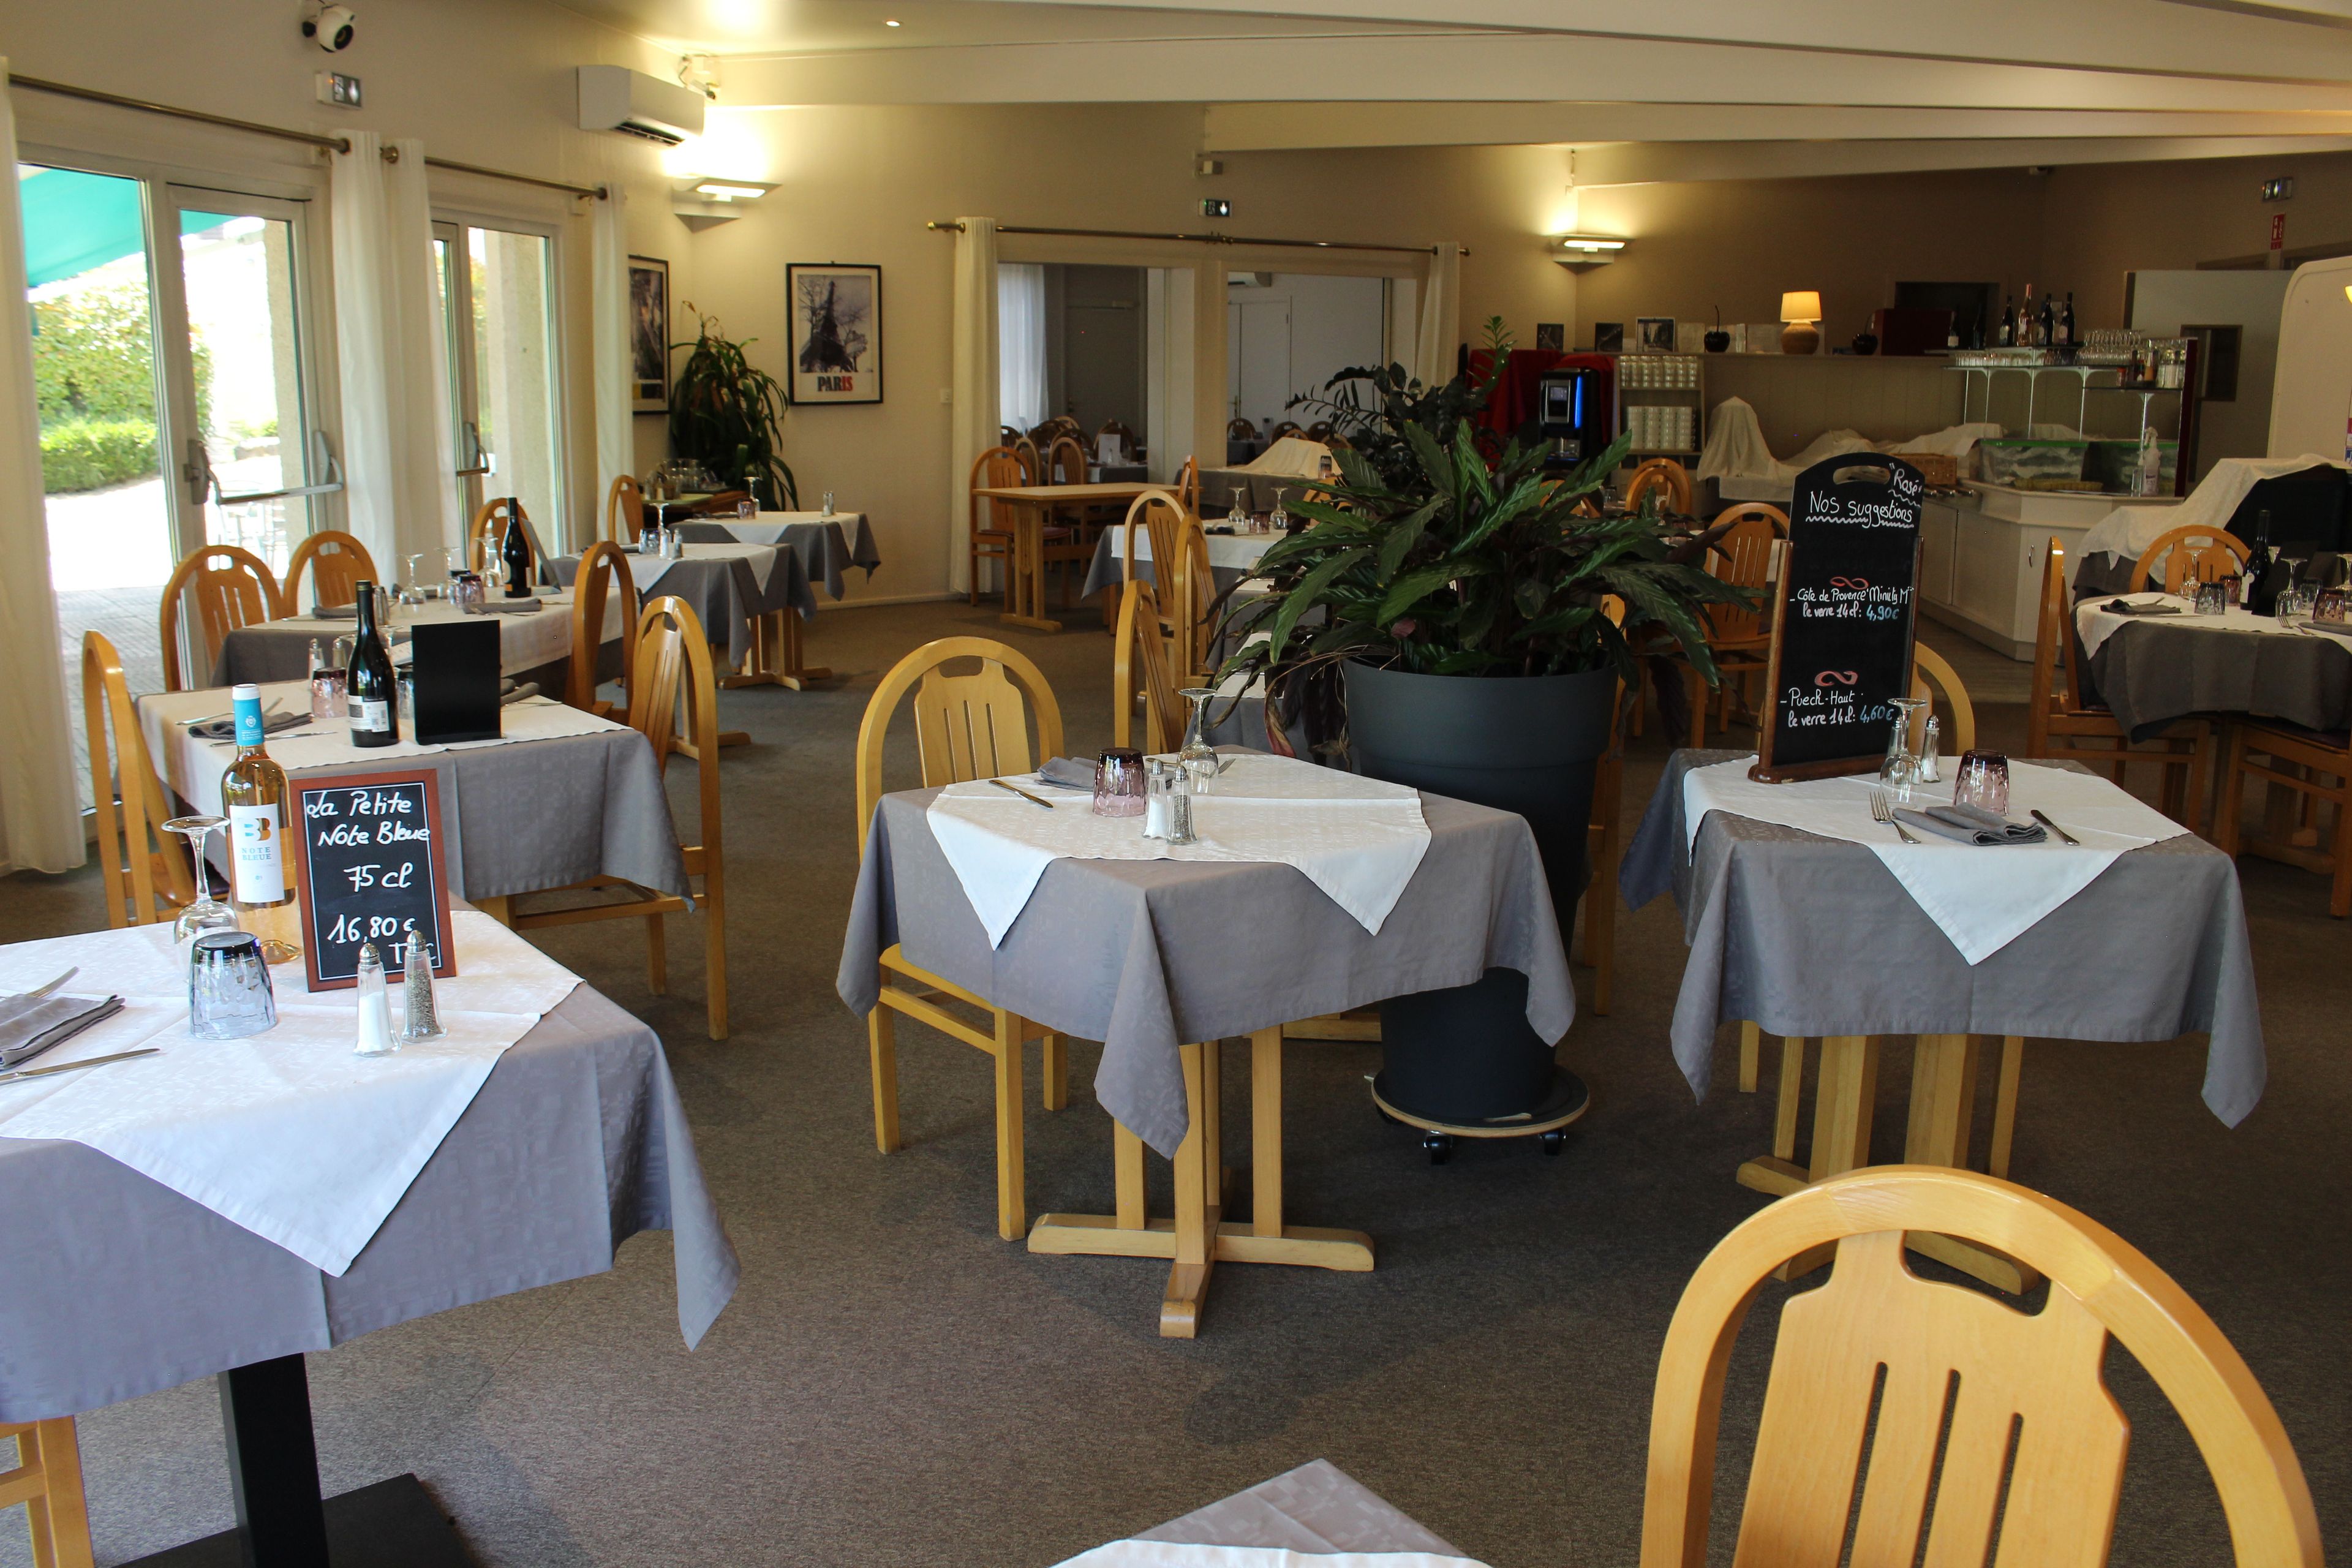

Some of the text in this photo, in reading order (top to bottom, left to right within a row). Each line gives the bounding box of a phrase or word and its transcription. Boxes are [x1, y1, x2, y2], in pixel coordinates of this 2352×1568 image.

[817, 375, 853, 391] PARIS
[1810, 491, 1913, 529] Nos suggestions
[1797, 587, 1817, 601] Côte
[1819, 589, 1830, 602] de
[1831, 588, 1866, 602] Provence
[1803, 601, 1812, 617] le
[1814, 606, 1834, 617] verre
[1788, 710, 1798, 728] le
[1801, 714, 1826, 726] verre
[306, 790, 412, 818] La Petite
[317, 820, 431, 846] Note Bleue
[343, 862, 413, 892] 75 cl
